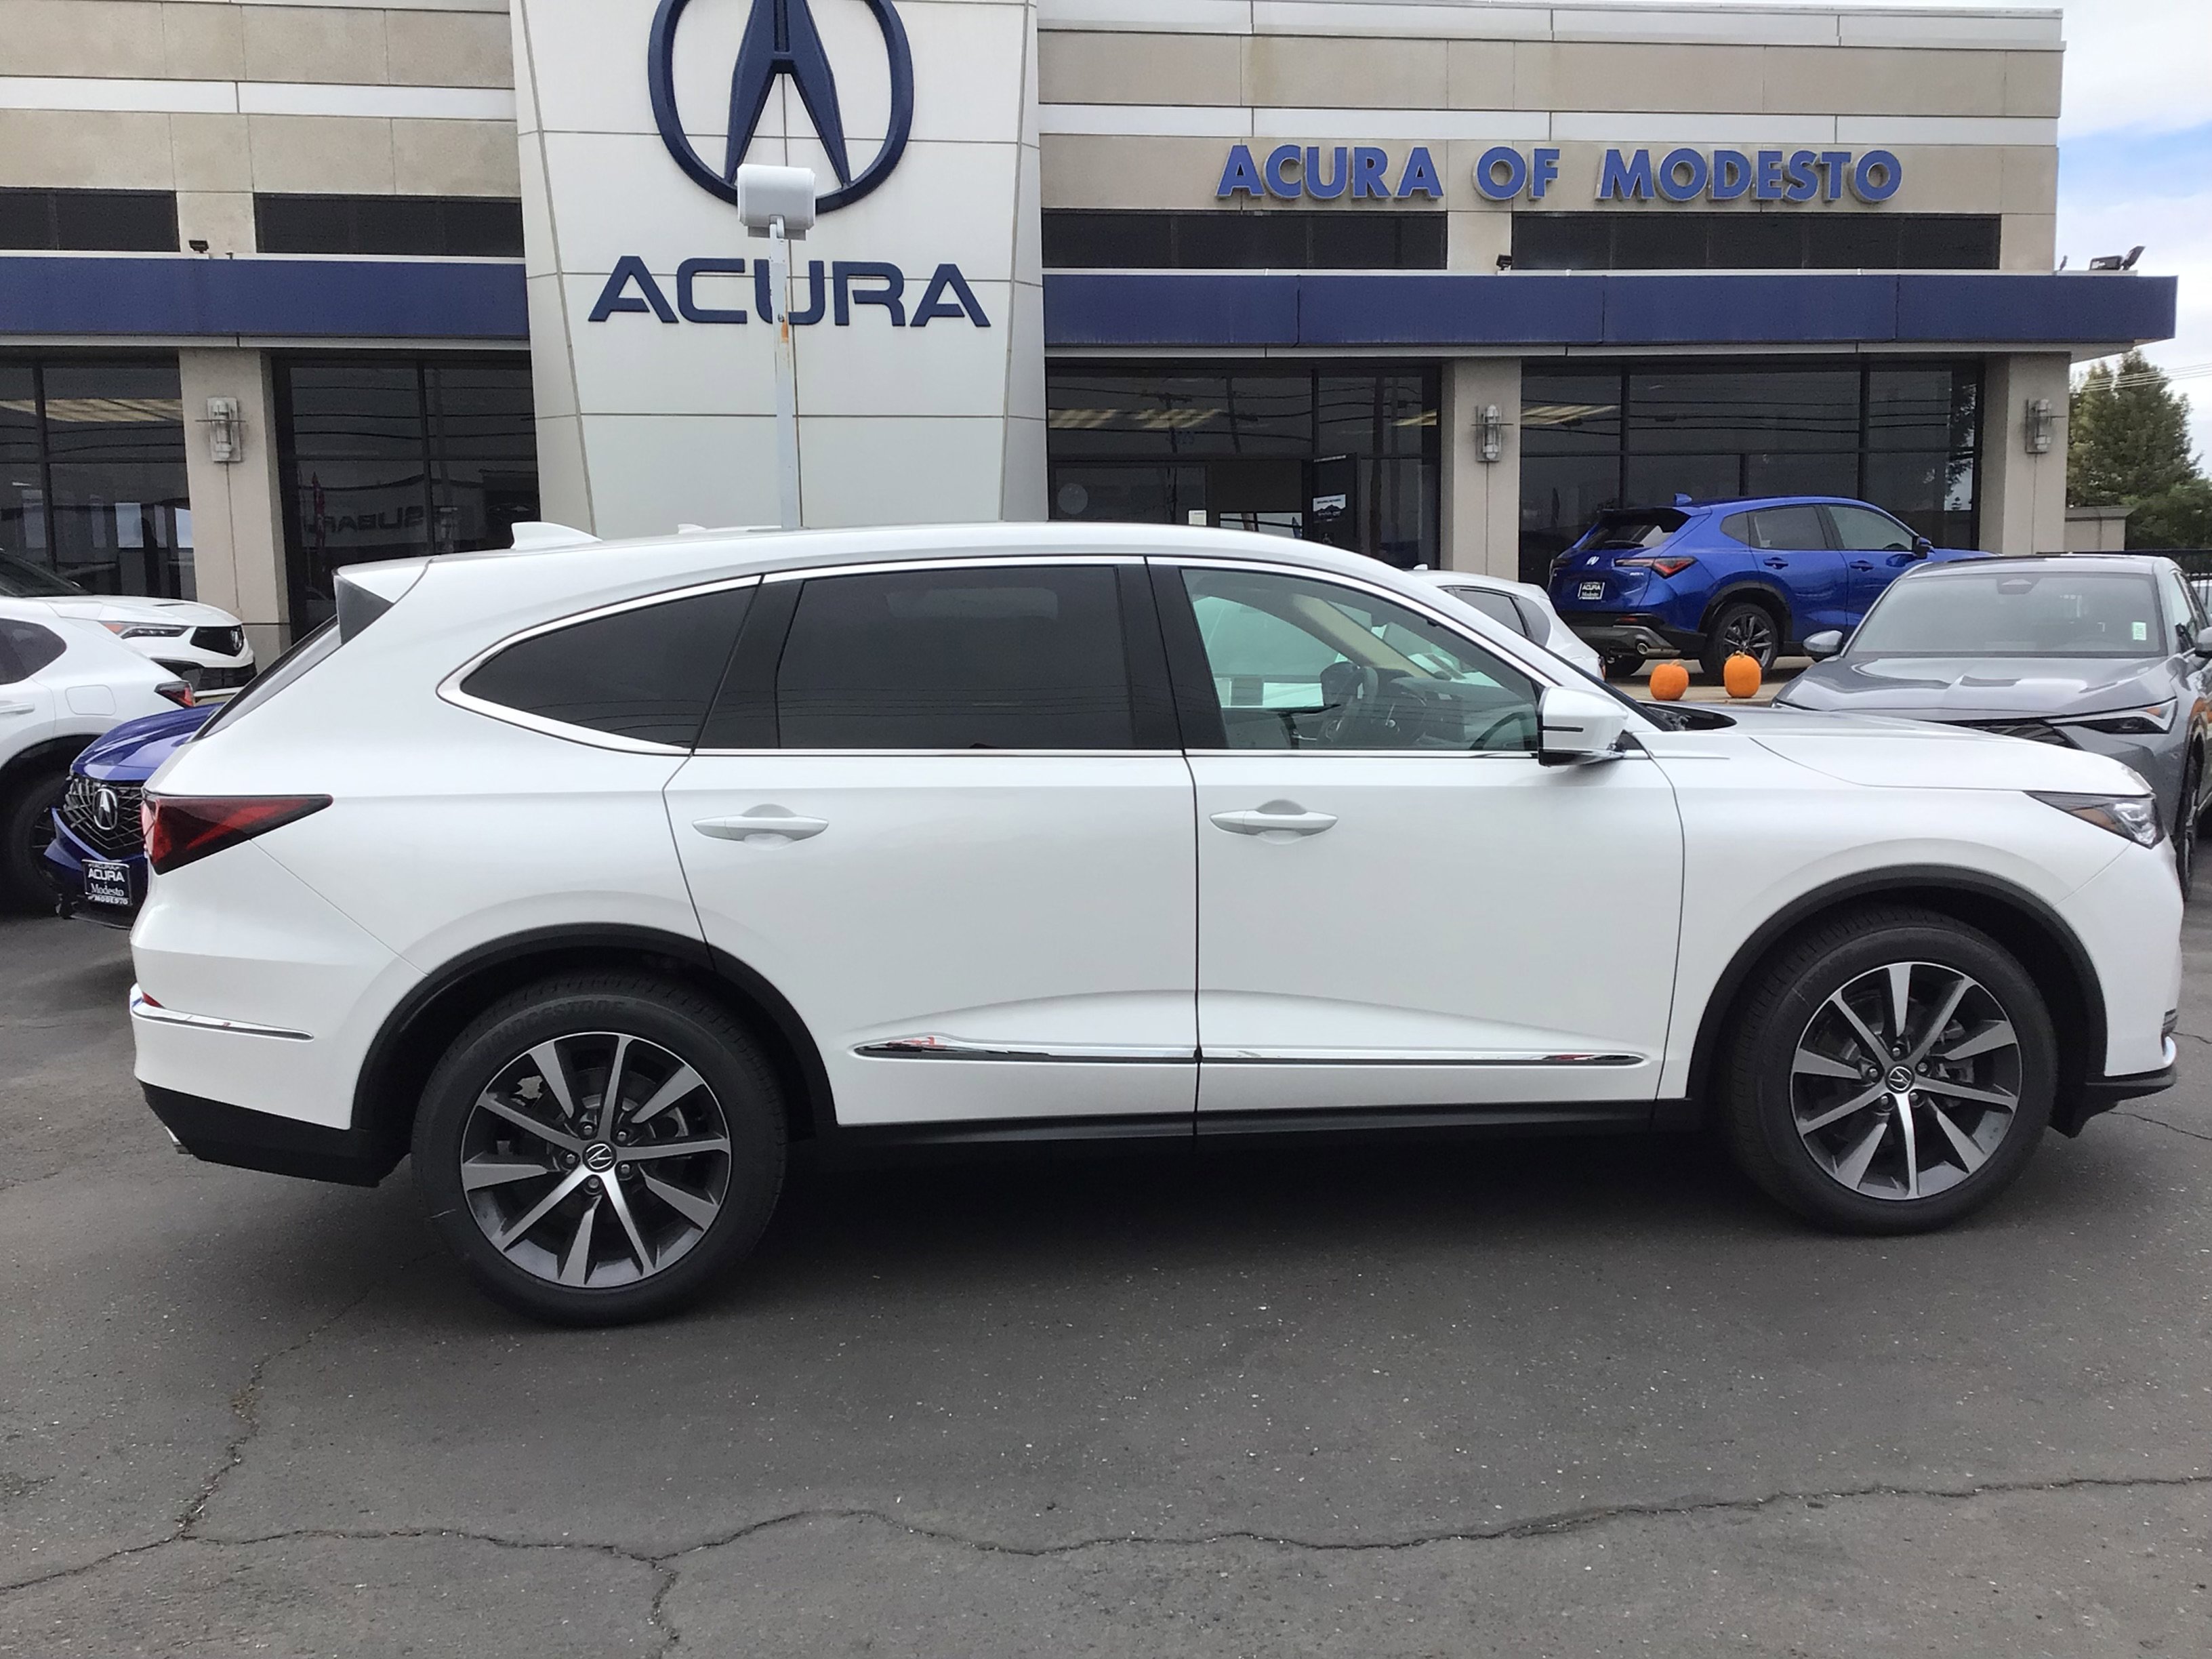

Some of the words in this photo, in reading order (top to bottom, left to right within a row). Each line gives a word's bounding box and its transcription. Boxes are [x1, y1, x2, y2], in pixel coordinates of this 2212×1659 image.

[1215, 144, 1444, 201] ACURA
[1472, 146, 1560, 201] OF
[1595, 148, 1903, 202] MODESTO
[588, 255, 991, 327] ACURA
[88, 868, 125, 882] ACURA
[91, 883, 124, 896] Modesto
